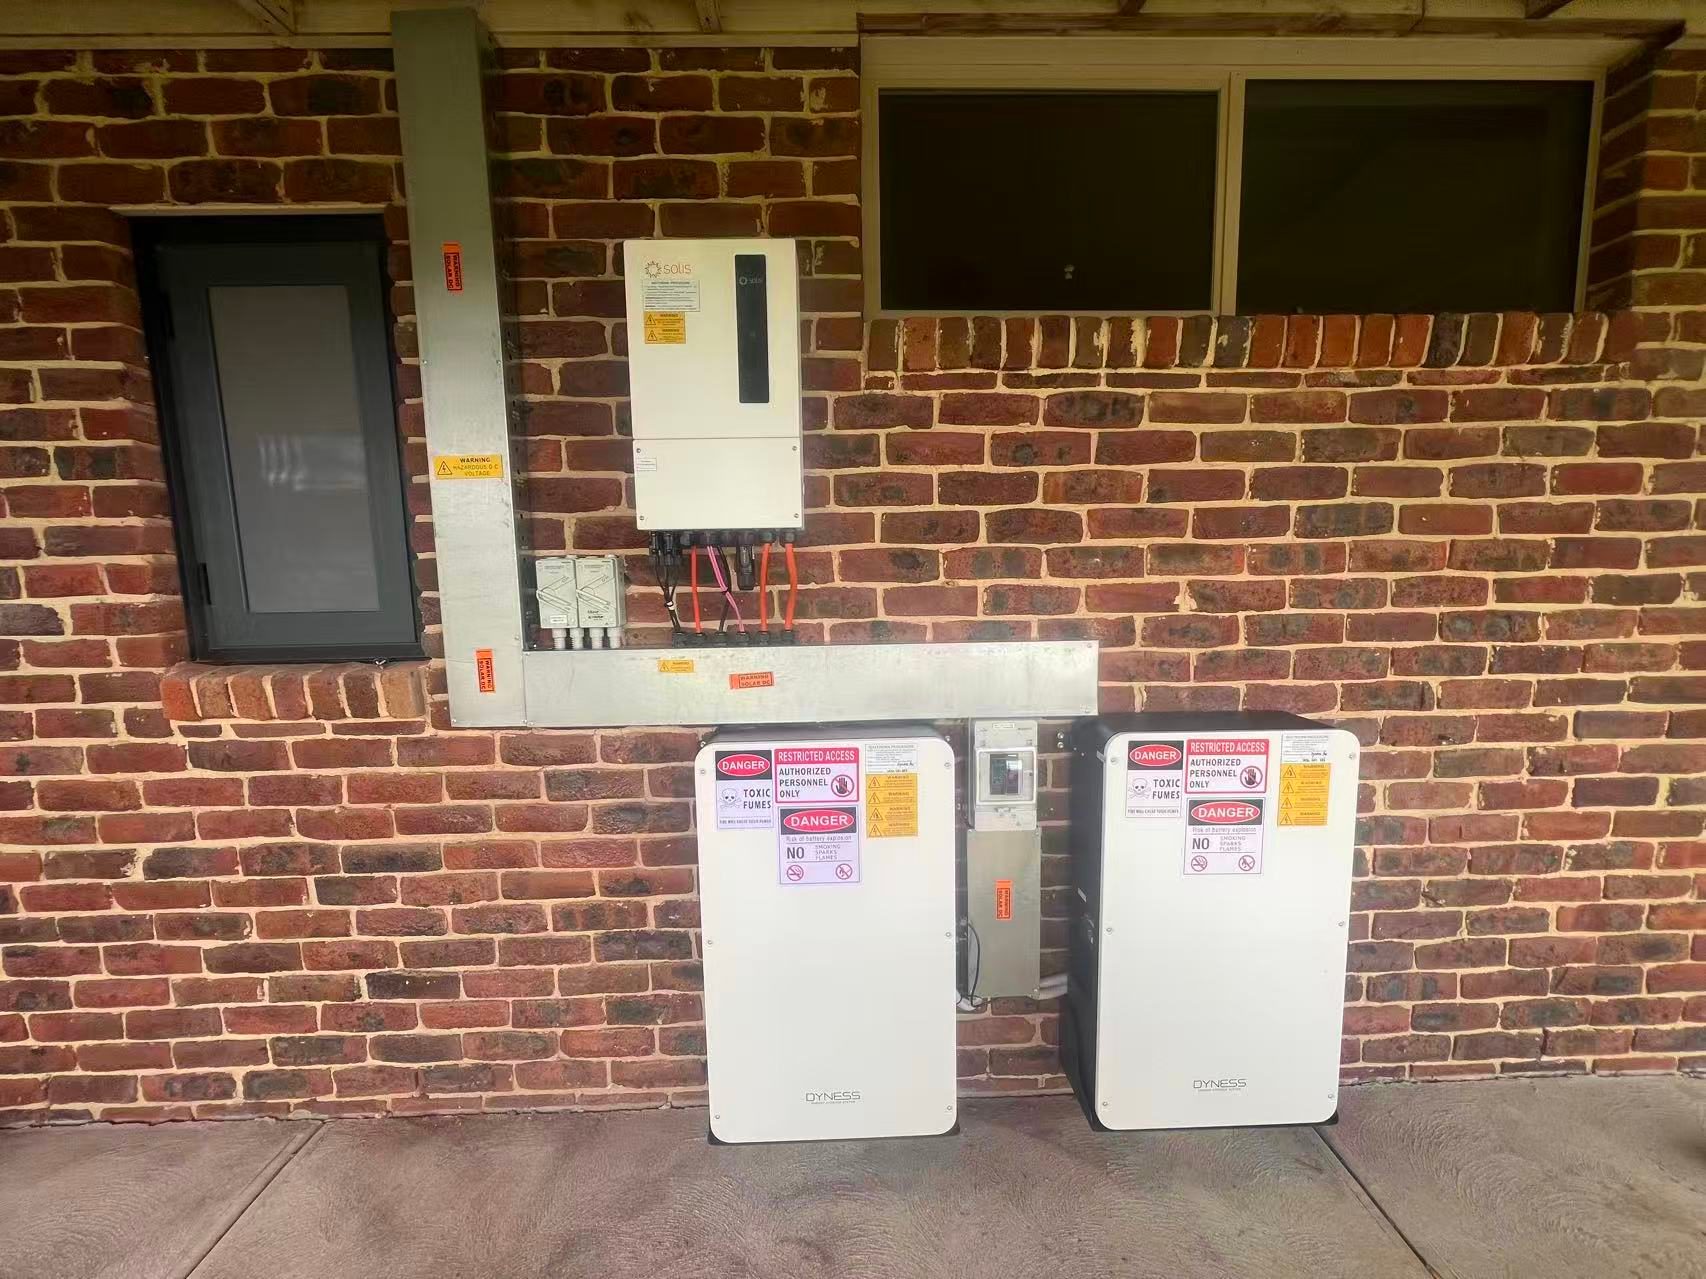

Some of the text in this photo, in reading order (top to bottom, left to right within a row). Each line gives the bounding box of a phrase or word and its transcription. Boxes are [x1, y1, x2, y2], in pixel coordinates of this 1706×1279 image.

[481, 681, 486, 690] DC
[1190, 742, 1265, 752] RESTRICTED ACCESS
[778, 751, 824, 762] RESTRICTED
[824, 750, 855, 760] ACCESS
[1134, 751, 1177, 760] DANGER
[722, 760, 766, 770] DANGER
[1190, 758, 1241, 766] AUTHORIZED
[779, 767, 832, 776] AUTHORIZED
[1190, 769, 1238, 778] PERSONNEL
[779, 778, 829, 787] PERSONNEL
[1154, 779, 1180, 788] TOXIC
[1189, 780, 1210, 788] ONLY
[743, 788, 771, 798] TOXIC
[780, 790, 800, 798] ONLY
[1152, 791, 1180, 800] FUMES
[743, 800, 772, 809] FUMES
[1198, 807, 1254, 818] DANGER
[790, 815, 848, 826] DANGER
[1192, 838, 1210, 850] NO
[786, 846, 804, 860] NO
[1193, 1078, 1247, 1088] DYNESS
[806, 1091, 861, 1102] DYNESS
